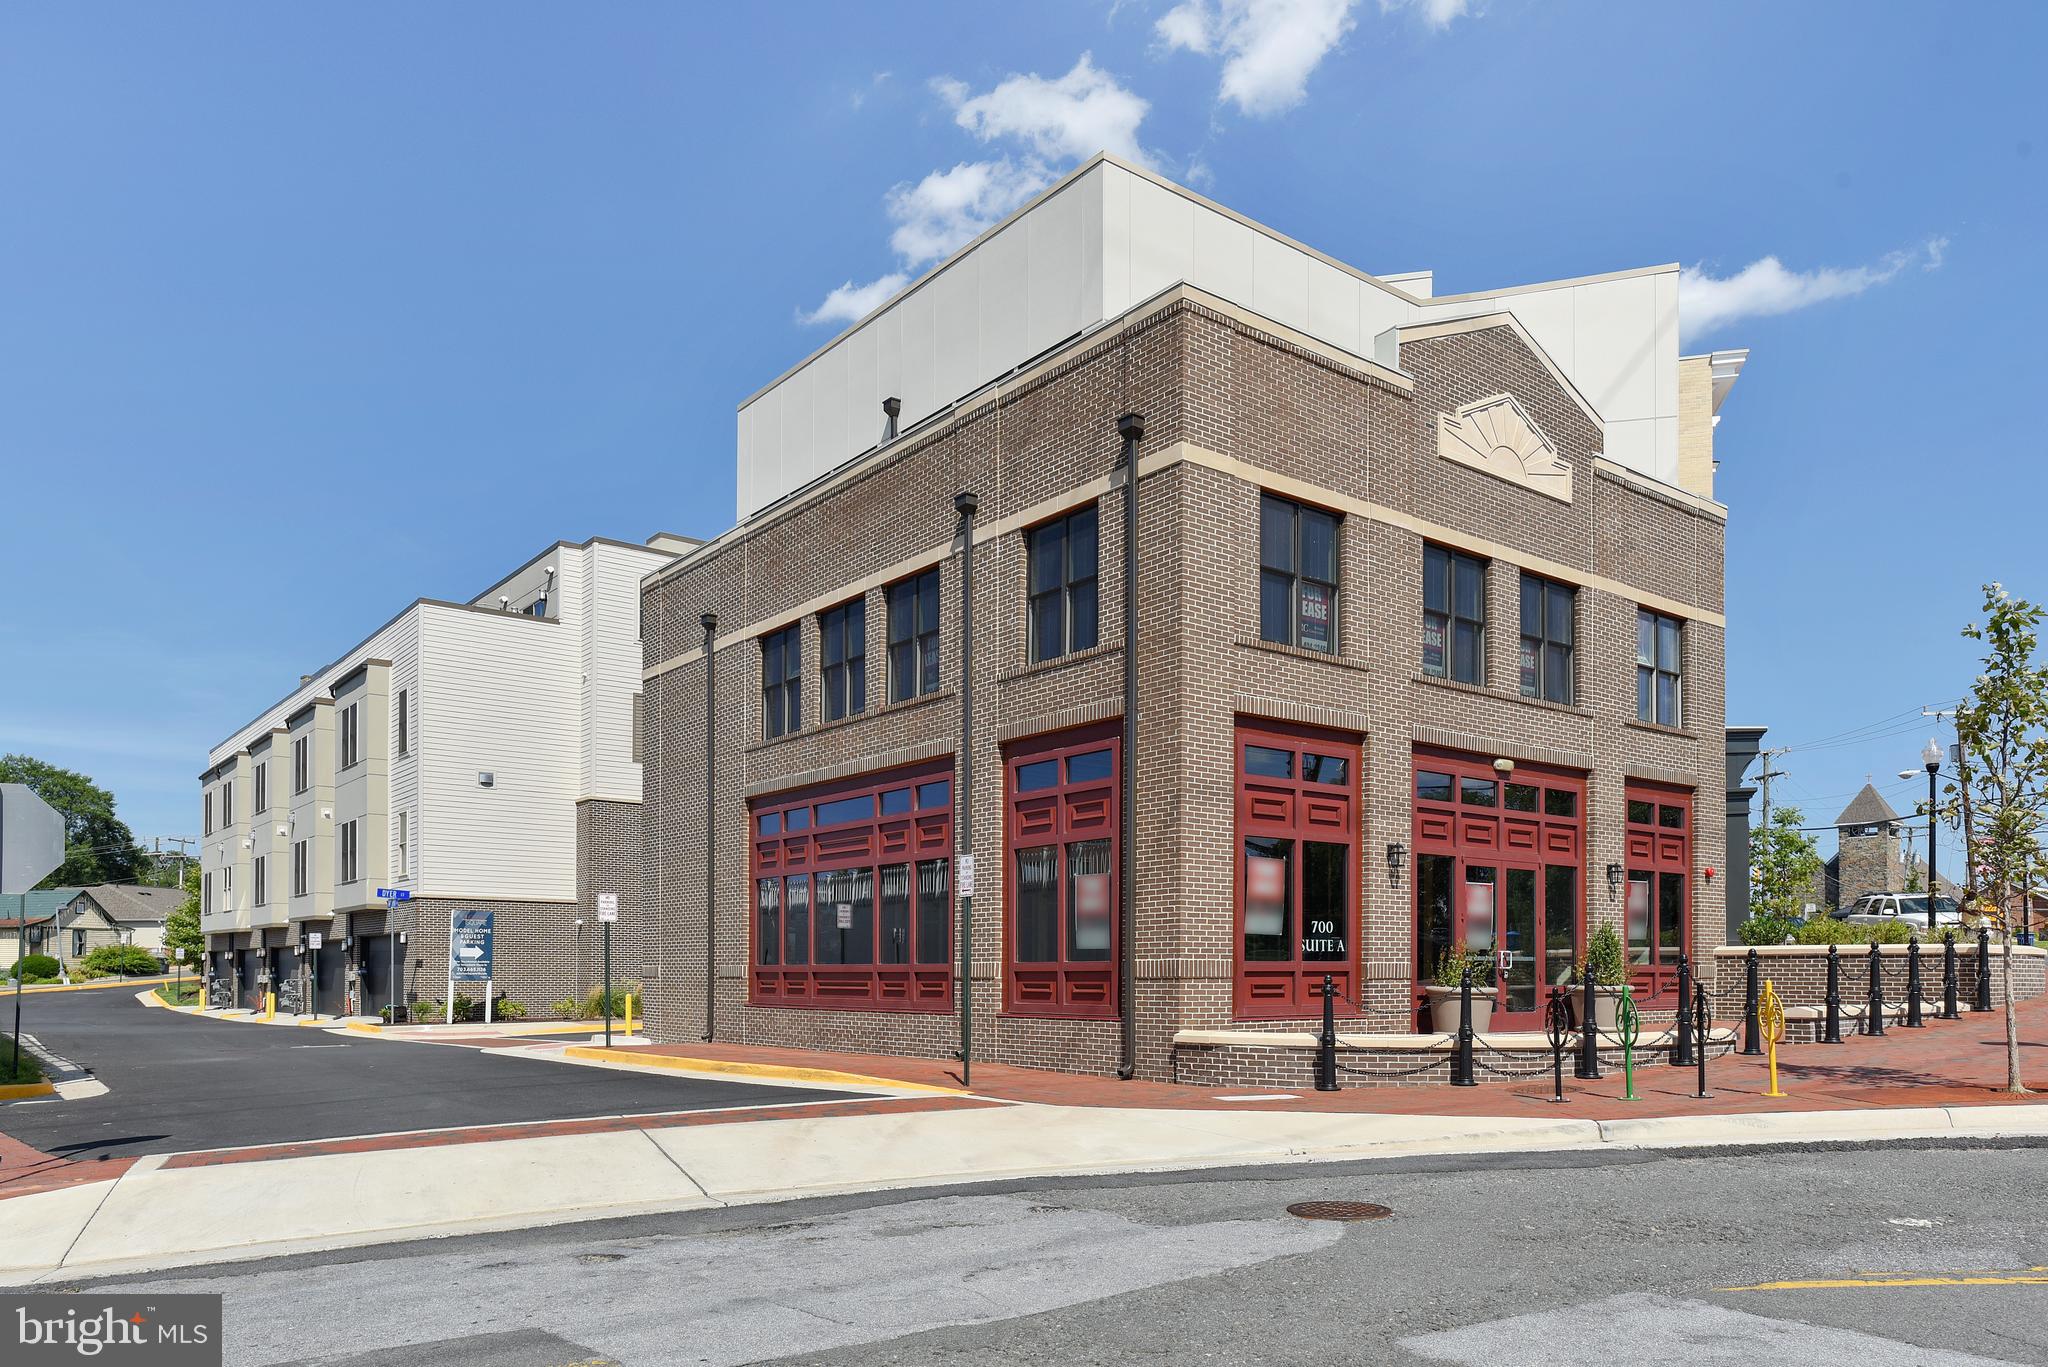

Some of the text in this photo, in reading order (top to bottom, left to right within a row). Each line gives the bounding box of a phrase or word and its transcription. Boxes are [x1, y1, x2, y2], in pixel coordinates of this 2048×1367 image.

[1302, 600, 1327, 621] EASE
[1423, 629, 1442, 648] ASE
[1520, 654, 1535, 670] ASE
[381, 889, 398, 899] DYER
[1311, 920, 1334, 934] 700
[1301, 939, 1345, 952] SUITE A
